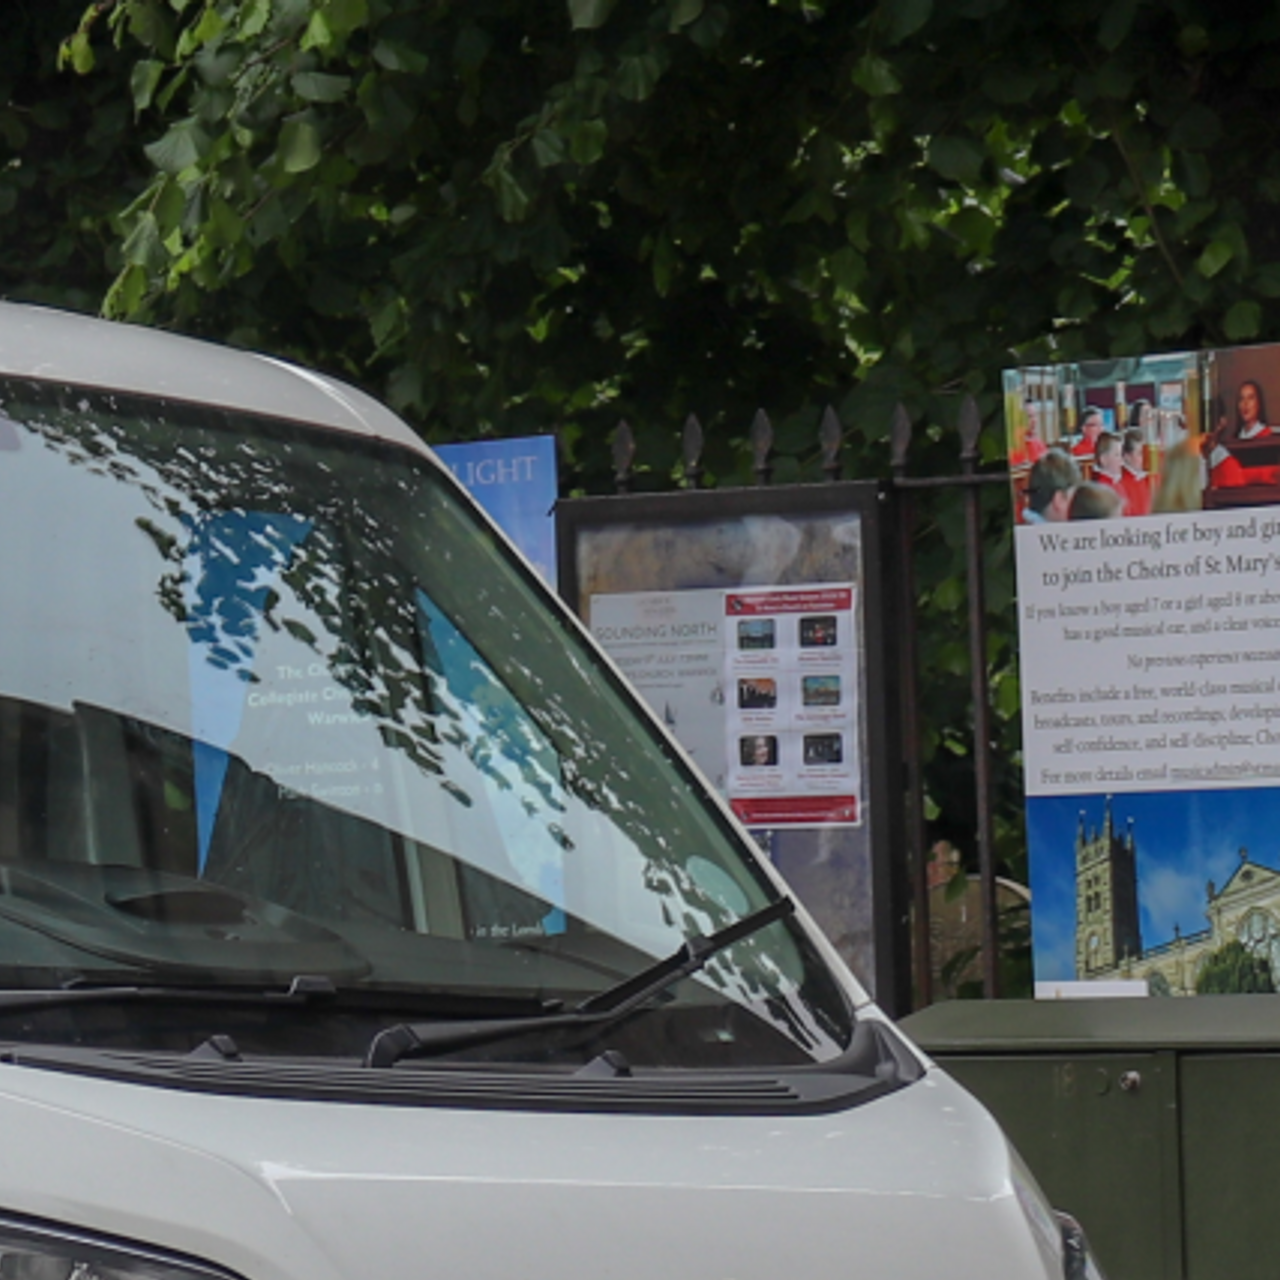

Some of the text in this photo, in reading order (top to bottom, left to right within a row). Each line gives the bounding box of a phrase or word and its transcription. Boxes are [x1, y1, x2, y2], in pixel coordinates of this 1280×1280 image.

[1038, 533, 1069, 552] We
[1072, 536, 1097, 551] are
[1100, 528, 1162, 550] looking
[1165, 523, 1189, 544] for
[1192, 522, 1222, 546] boy
[1226, 517, 1257, 539] and
[1042, 571, 1059, 586] to
[1061, 567, 1091, 591] join
[1097, 562, 1122, 583] the
[1126, 559, 1181, 581] Choirs
[1183, 555, 1203, 577] of
[1205, 555, 1222, 575] St
[276, 664, 304, 679] The
